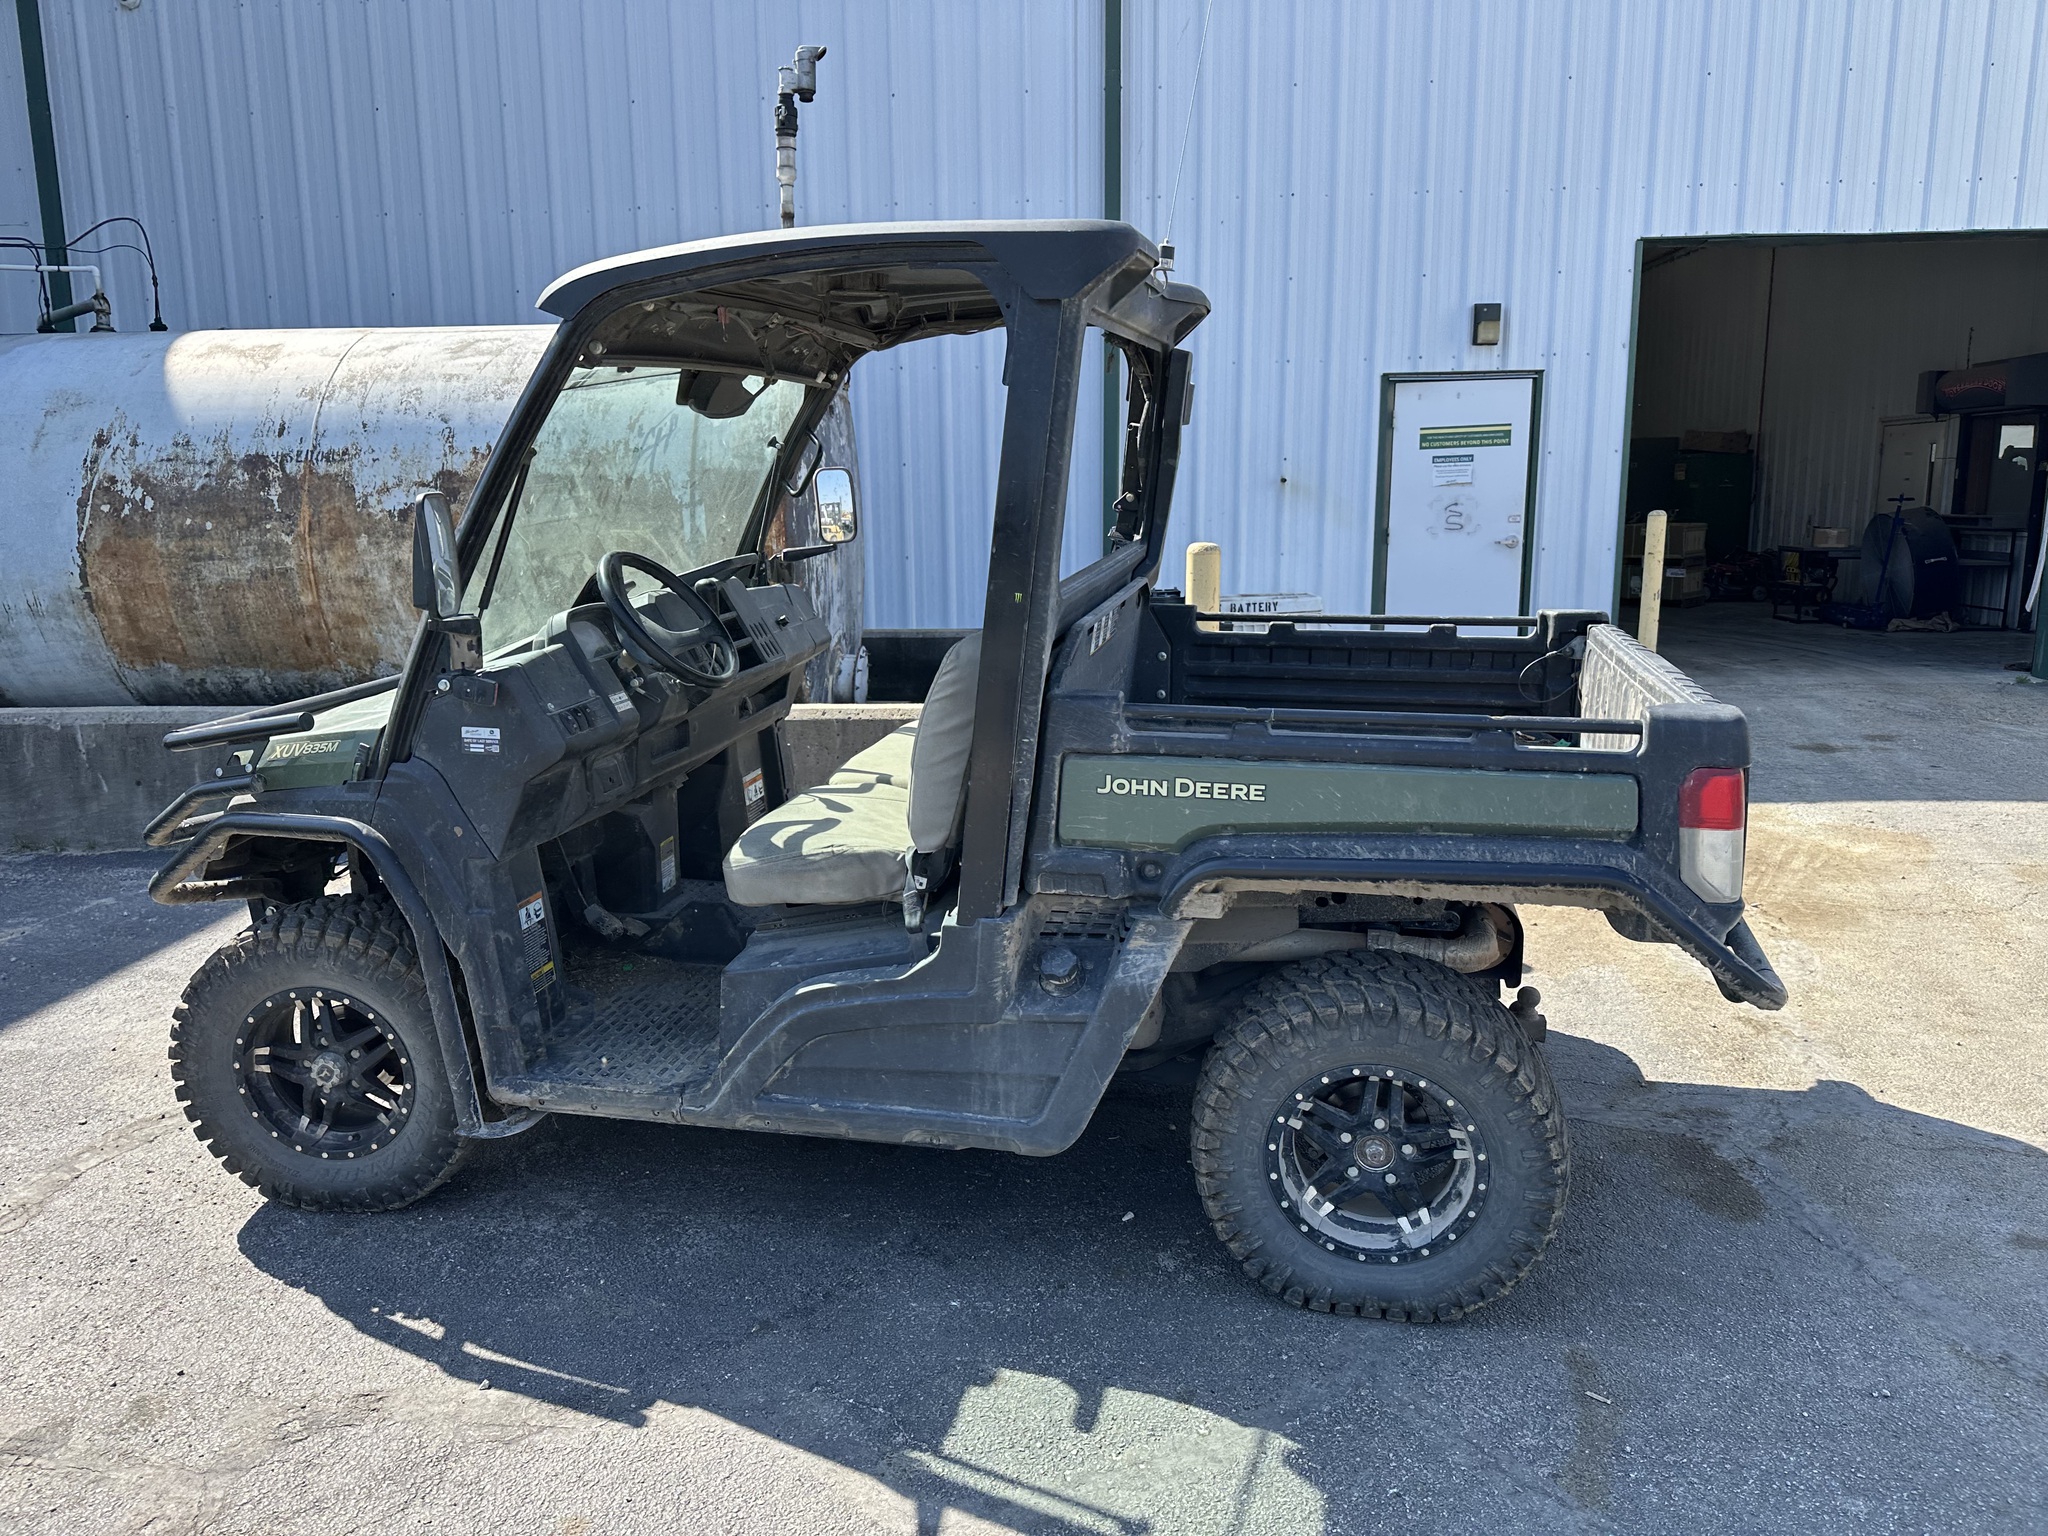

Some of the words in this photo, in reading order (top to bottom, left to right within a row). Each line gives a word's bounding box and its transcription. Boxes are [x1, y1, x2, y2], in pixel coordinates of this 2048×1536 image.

[1230, 601, 1278, 613] BATTERY
[270, 742, 340, 758] XUV835M
[1096, 774, 1168, 797] JOHN
[1174, 776, 1267, 802] DEERE
